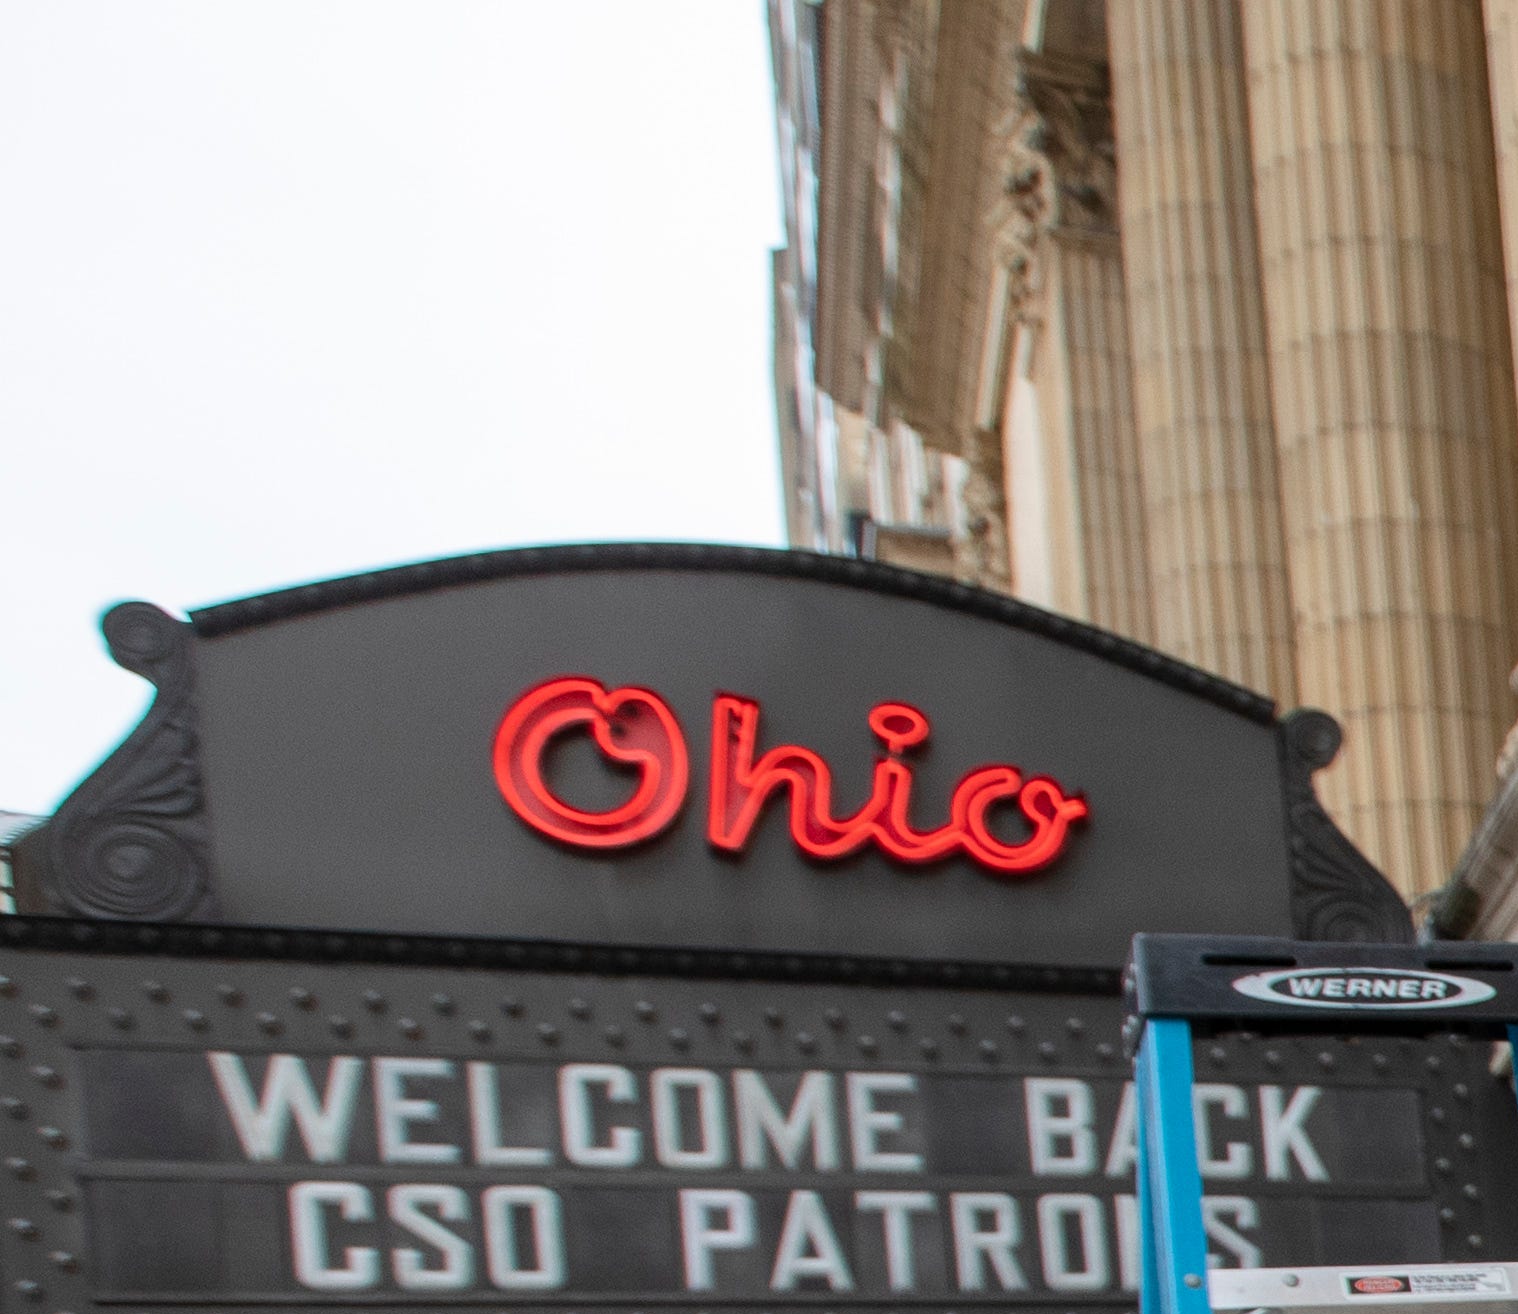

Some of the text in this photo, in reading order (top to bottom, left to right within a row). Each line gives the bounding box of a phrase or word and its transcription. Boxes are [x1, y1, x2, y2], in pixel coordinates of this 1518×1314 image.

[492, 675, 1088, 871] Ohio
[1287, 977, 1448, 1000] WERNER
[206, 1052, 926, 1172] WELCOME
[288, 1181, 568, 1292] CSO
